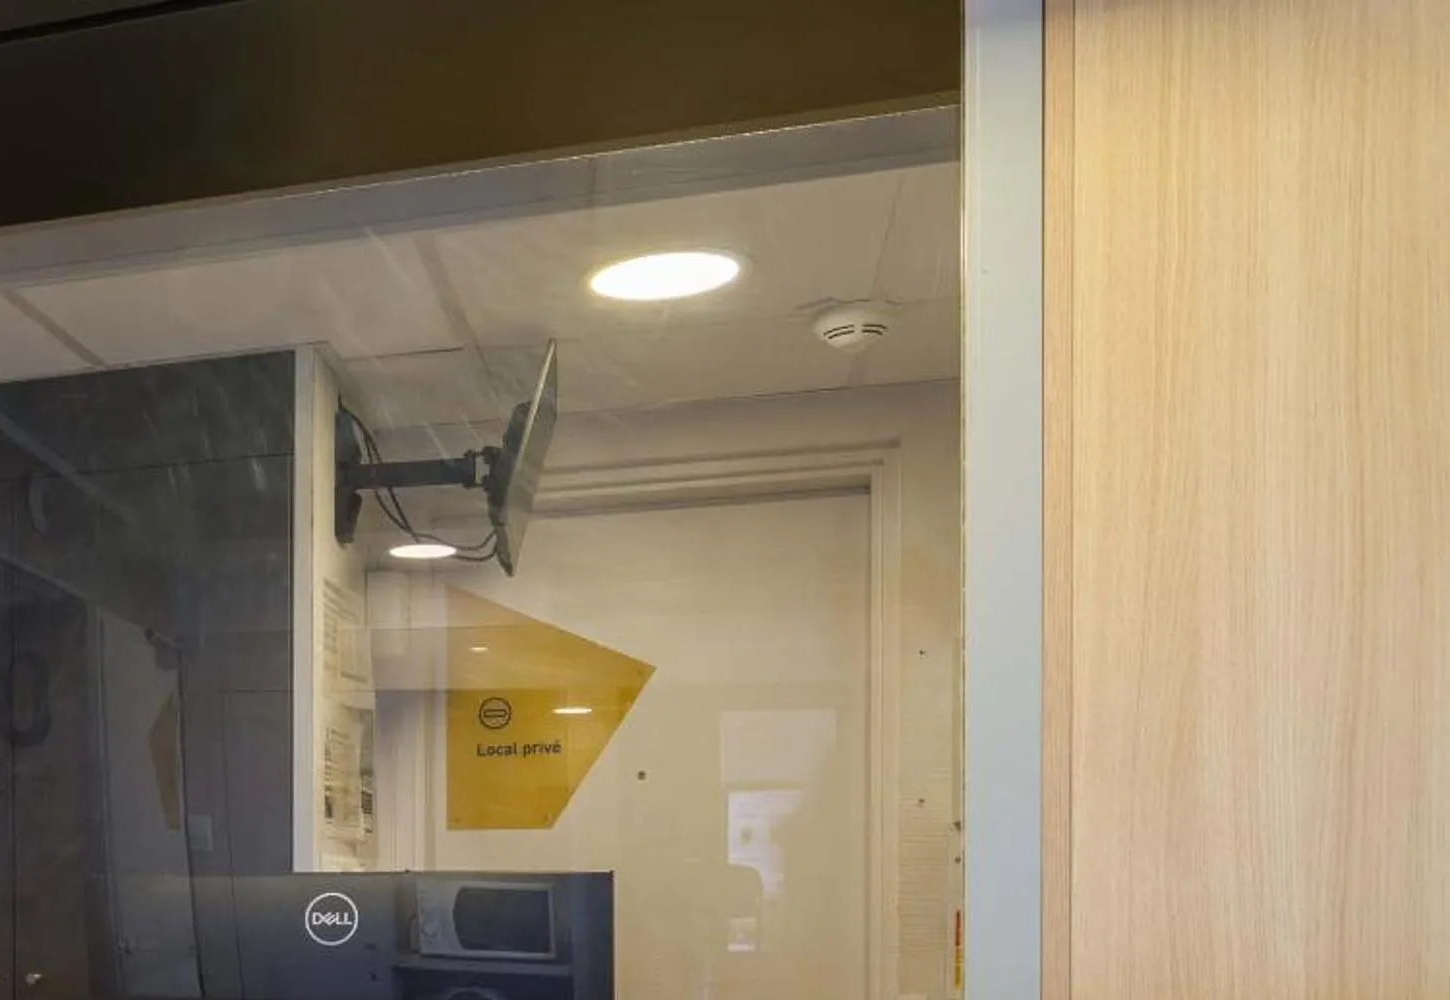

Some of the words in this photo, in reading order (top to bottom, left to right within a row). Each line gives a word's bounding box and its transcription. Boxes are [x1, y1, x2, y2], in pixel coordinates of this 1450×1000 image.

[476, 743, 517, 757] Local
[523, 739, 562, 758] privé
[312, 912, 353, 925] DELL
